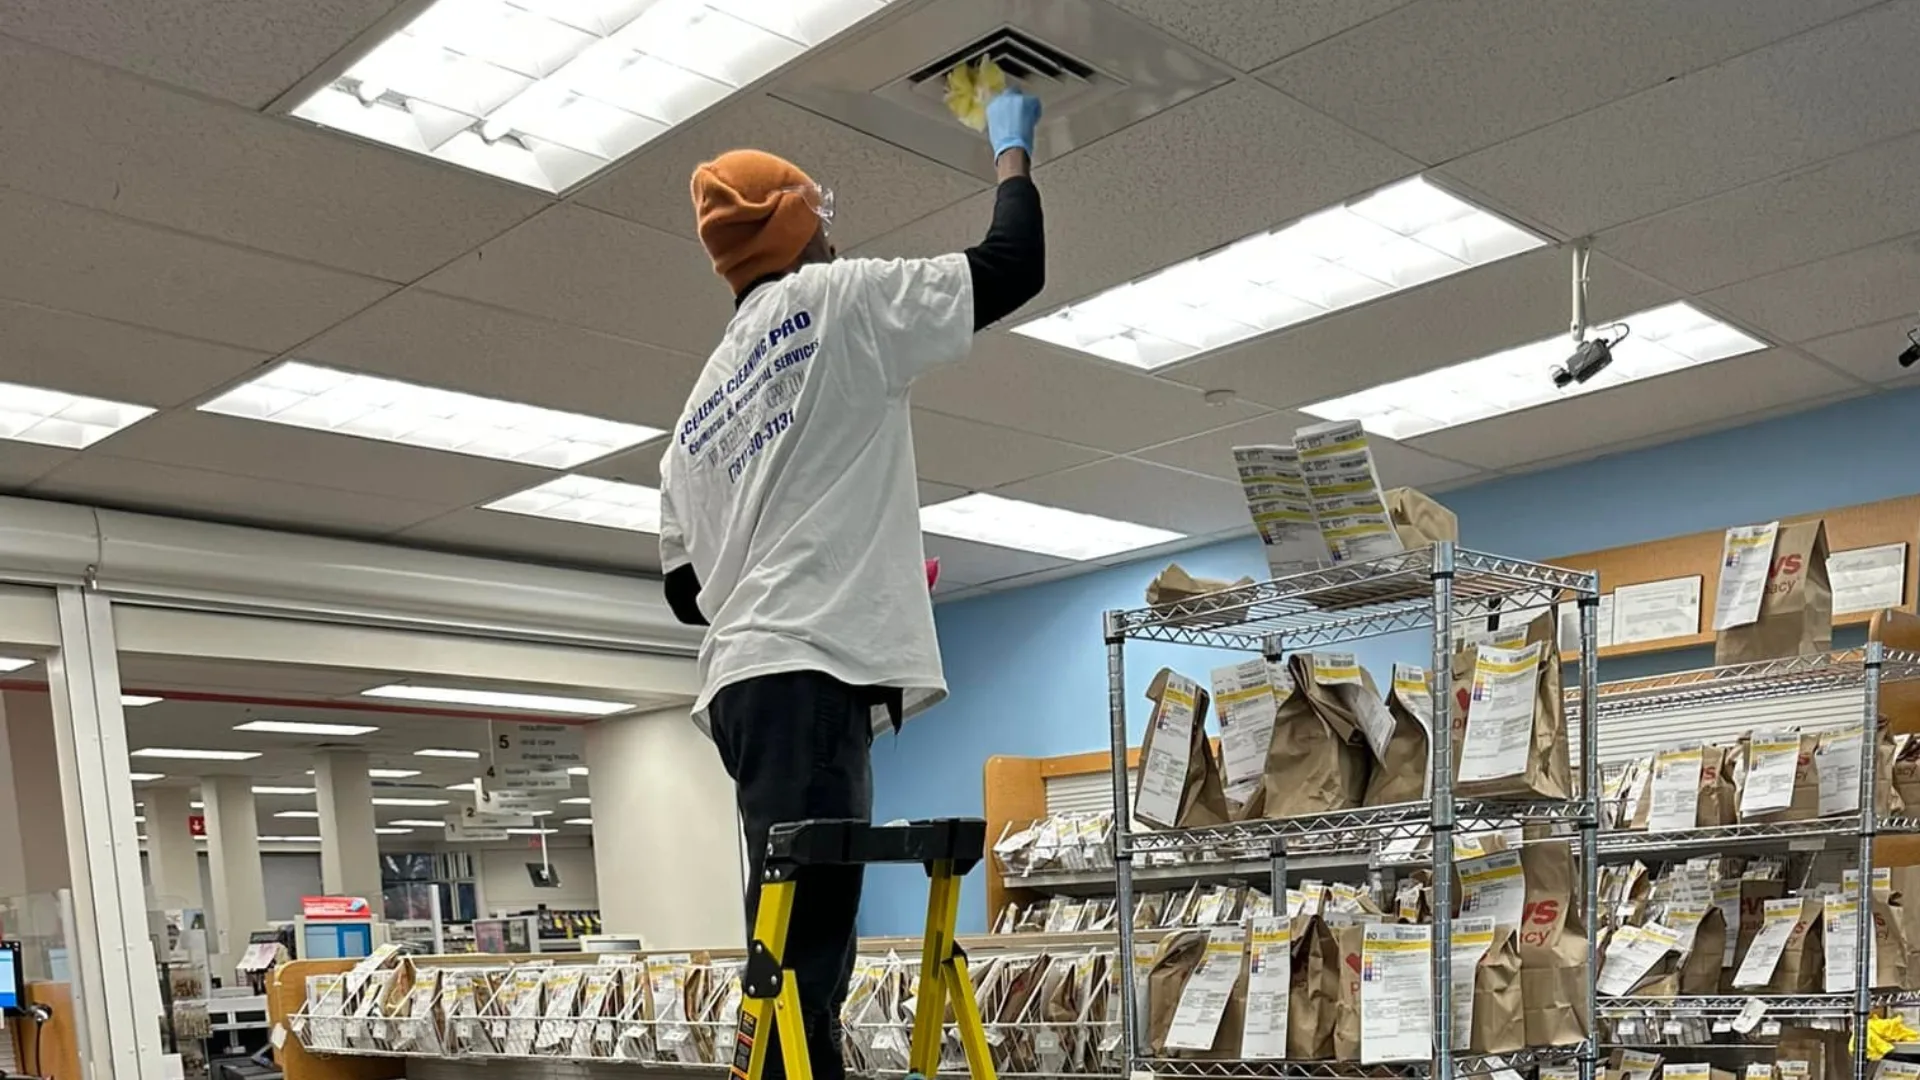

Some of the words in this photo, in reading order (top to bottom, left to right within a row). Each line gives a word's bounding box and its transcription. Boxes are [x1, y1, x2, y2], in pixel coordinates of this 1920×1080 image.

[727, 338, 767, 394] CLEANING
[769, 311, 811, 347] PRO
[727, 408, 736, 421] &
[1769, 553, 1802, 578] VS
[499, 734, 510, 749] 5
[486, 766, 495, 777] 4
[466, 807, 475, 817] 2
[450, 823, 455, 833] 1
[1522, 900, 1559, 924] VS
